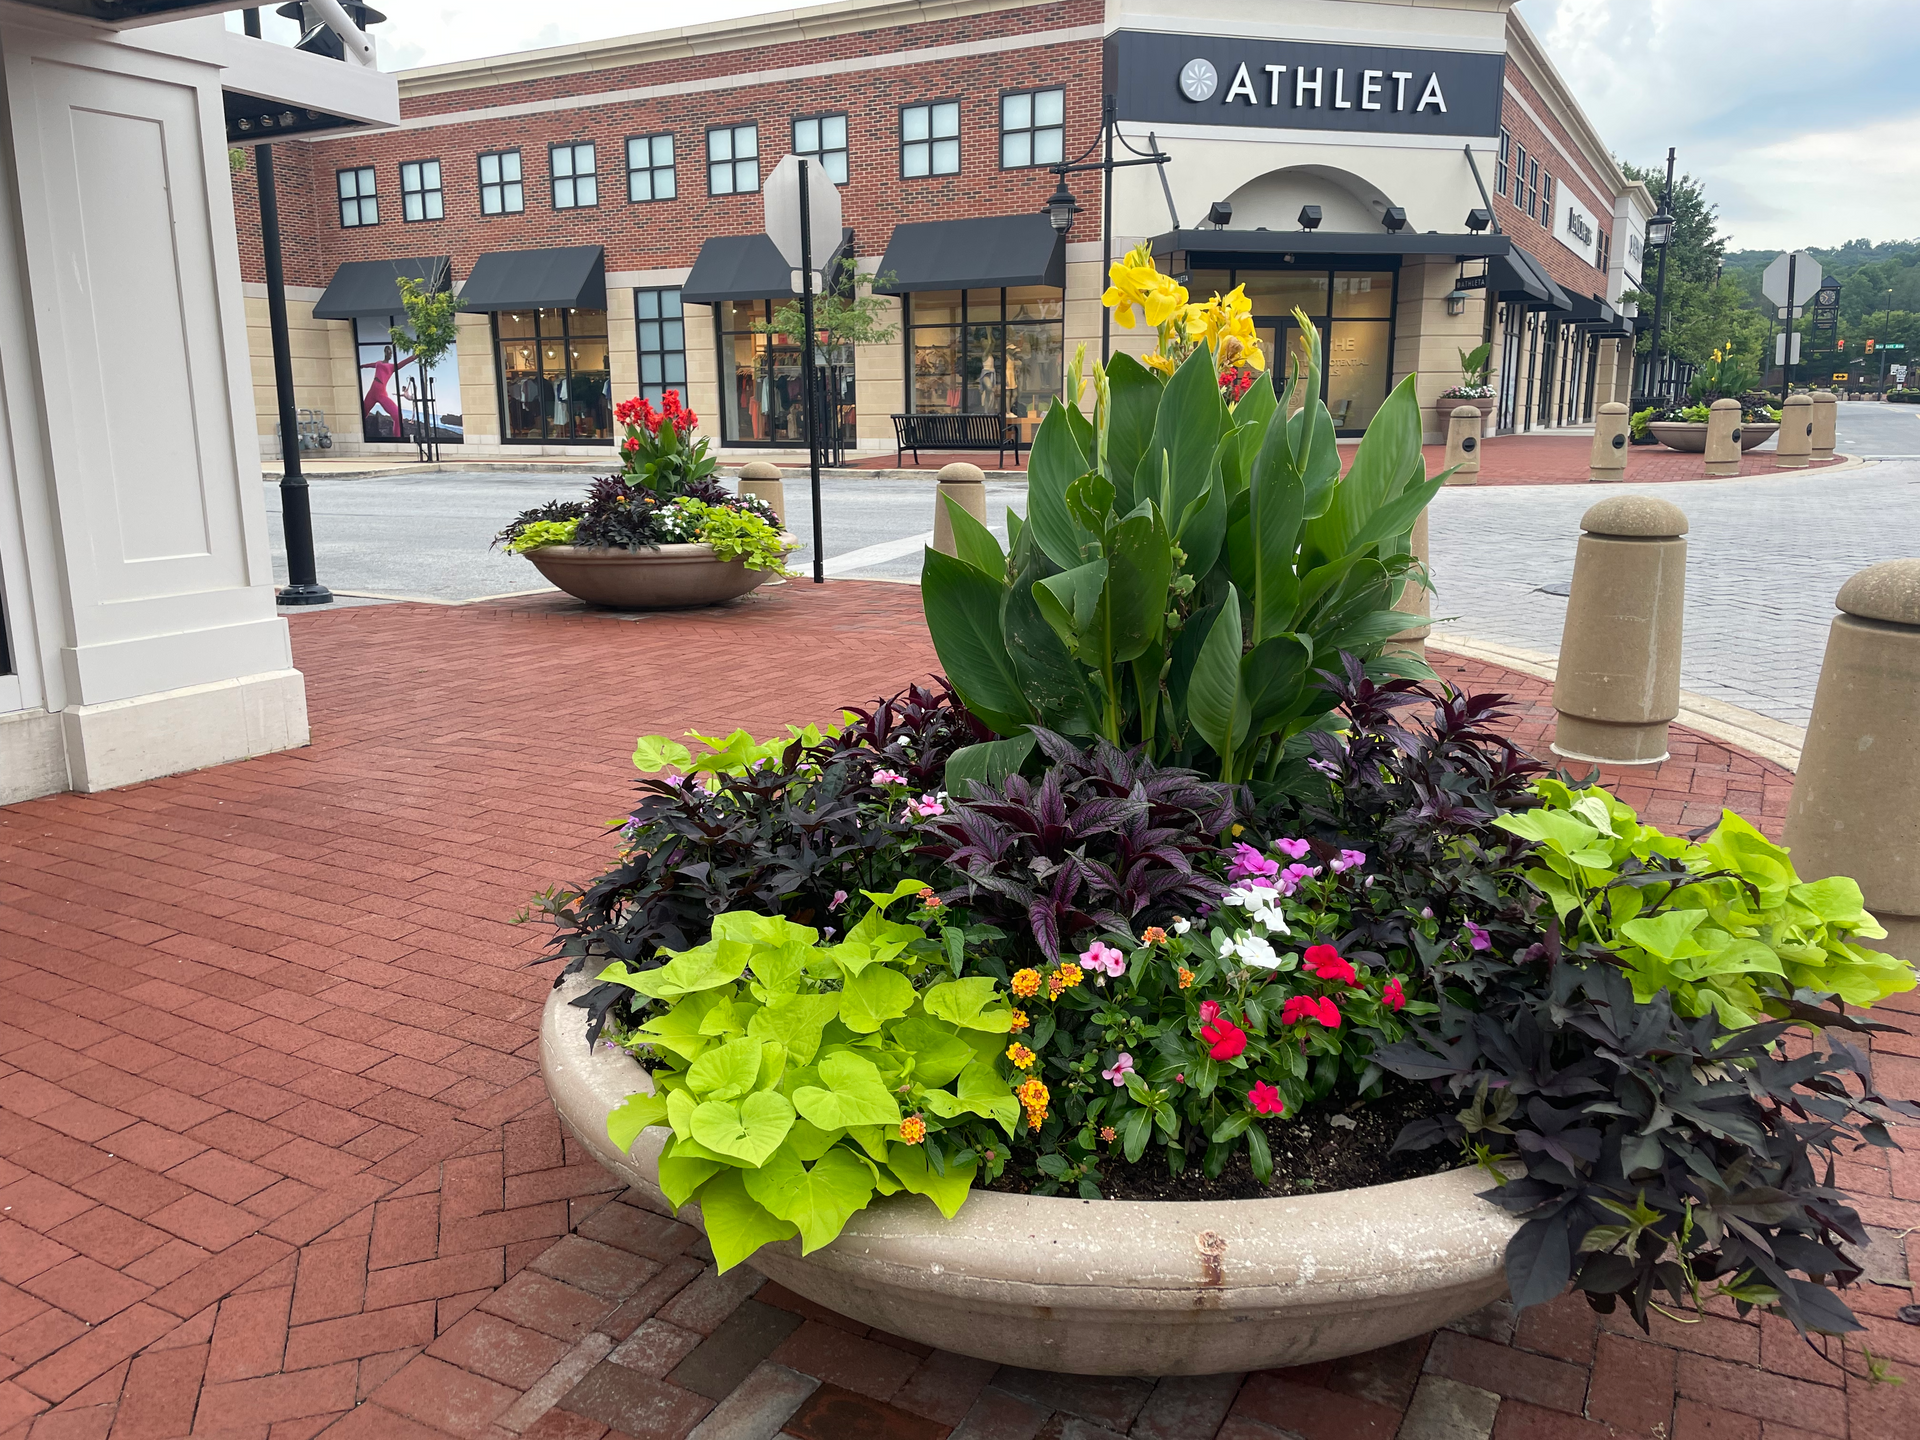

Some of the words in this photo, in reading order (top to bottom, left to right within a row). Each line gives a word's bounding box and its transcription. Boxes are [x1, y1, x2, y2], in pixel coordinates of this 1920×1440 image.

[1224, 61, 1448, 113] ATHLETA
[1461, 279, 1485, 287] ATHLETA
[1330, 338, 1355, 351] HE
